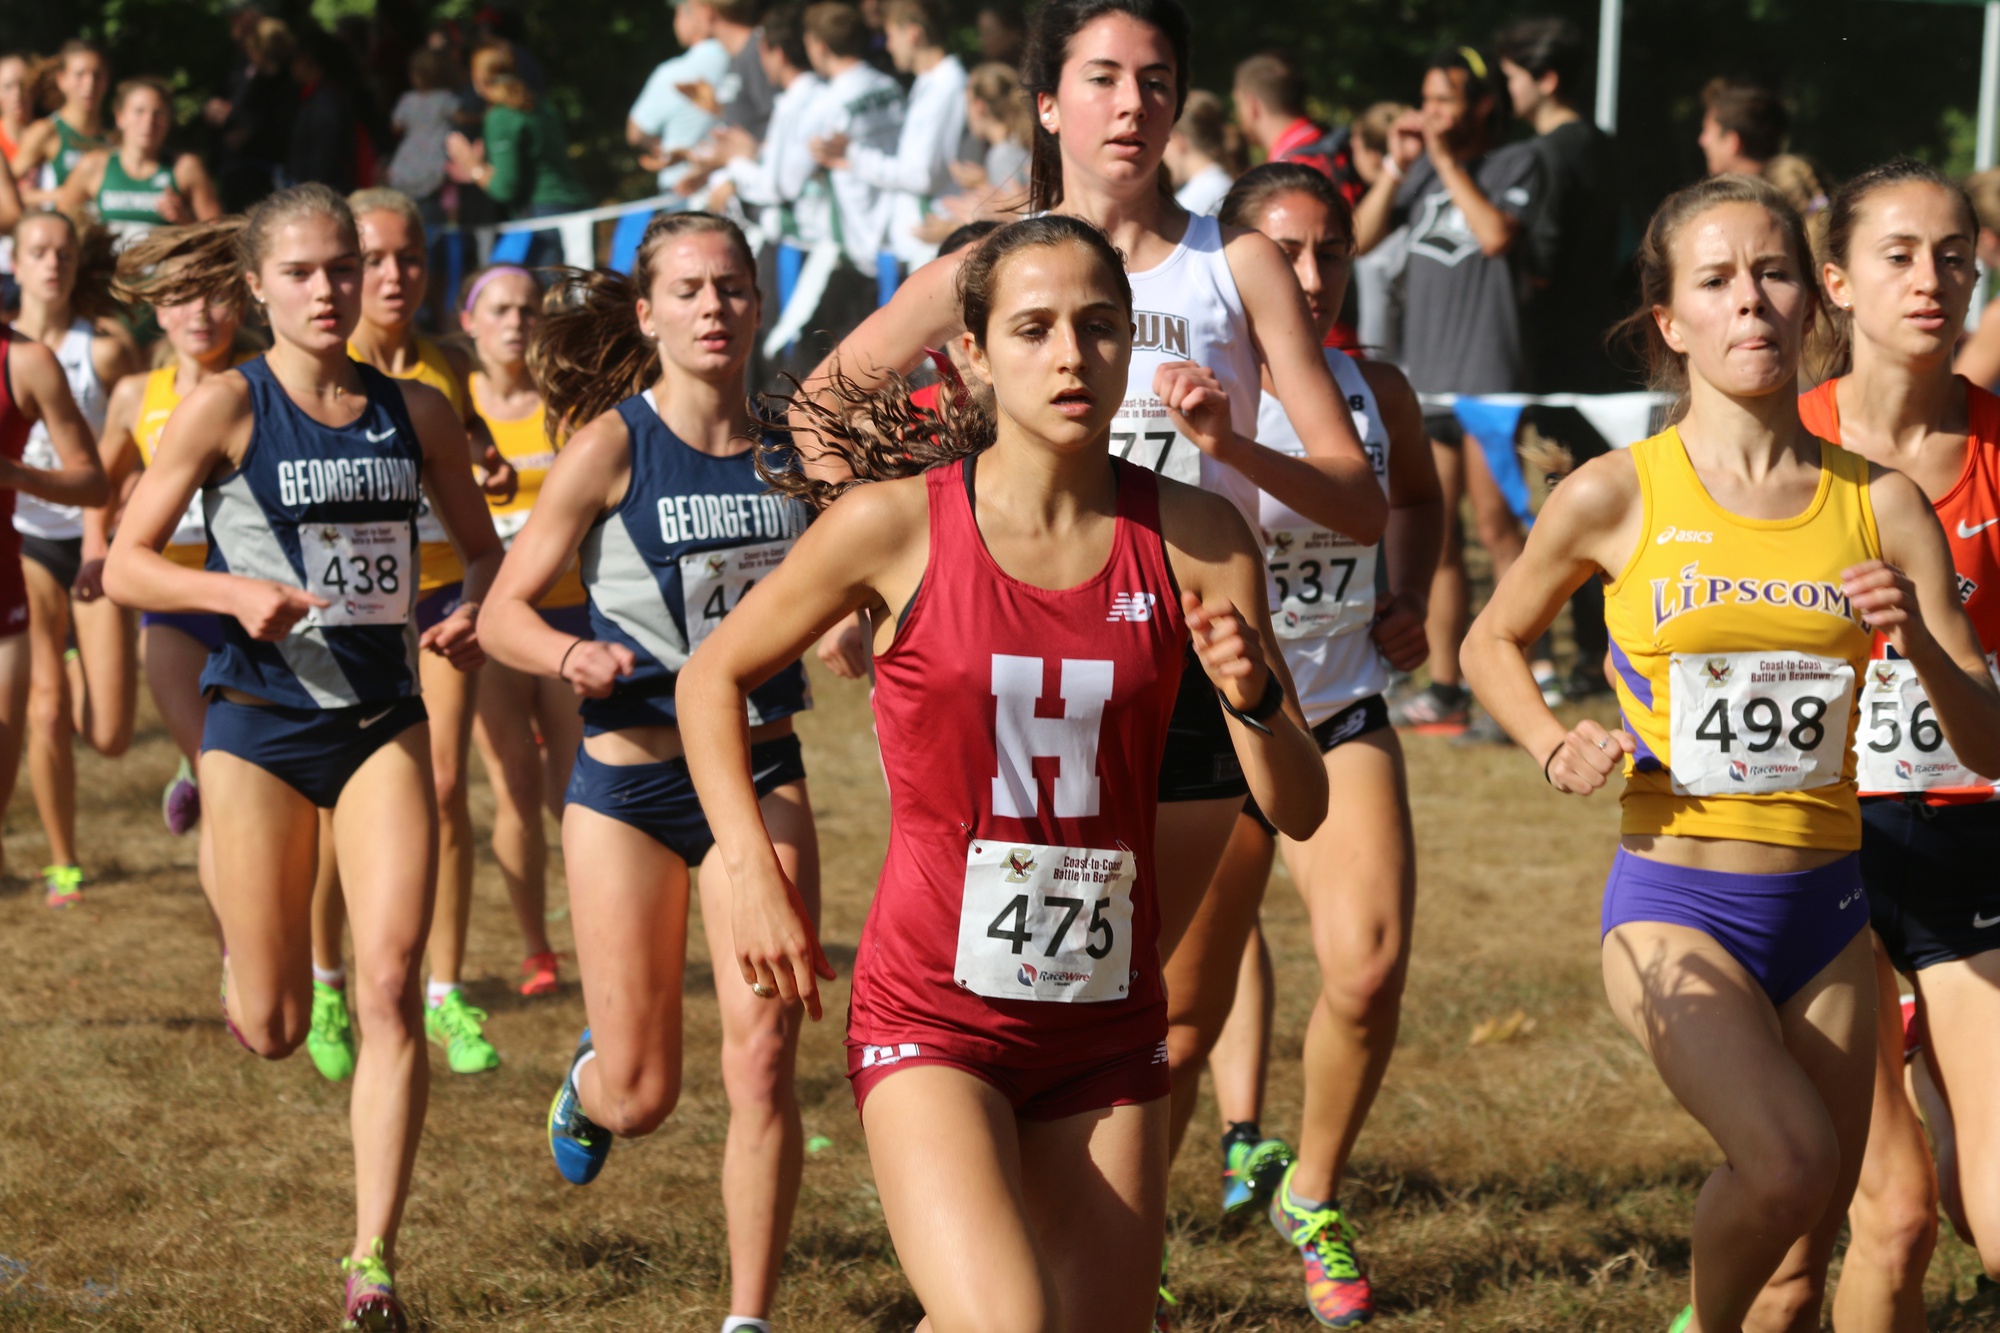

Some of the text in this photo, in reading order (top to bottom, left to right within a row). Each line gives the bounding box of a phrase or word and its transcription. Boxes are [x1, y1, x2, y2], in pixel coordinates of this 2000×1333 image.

[323, 555, 399, 595] 438
[1268, 557, 1357, 605] 537
[1751, 672, 1776, 683] Battle
[1778, 672, 1787, 681] in
[990, 653, 1115, 819] H
[1696, 696, 1828, 753] 498
[1750, 764, 1799, 776] RaceWire
[1053, 868, 1080, 882] Battle
[1081, 872, 1091, 882] in
[986, 894, 1113, 960] 475
